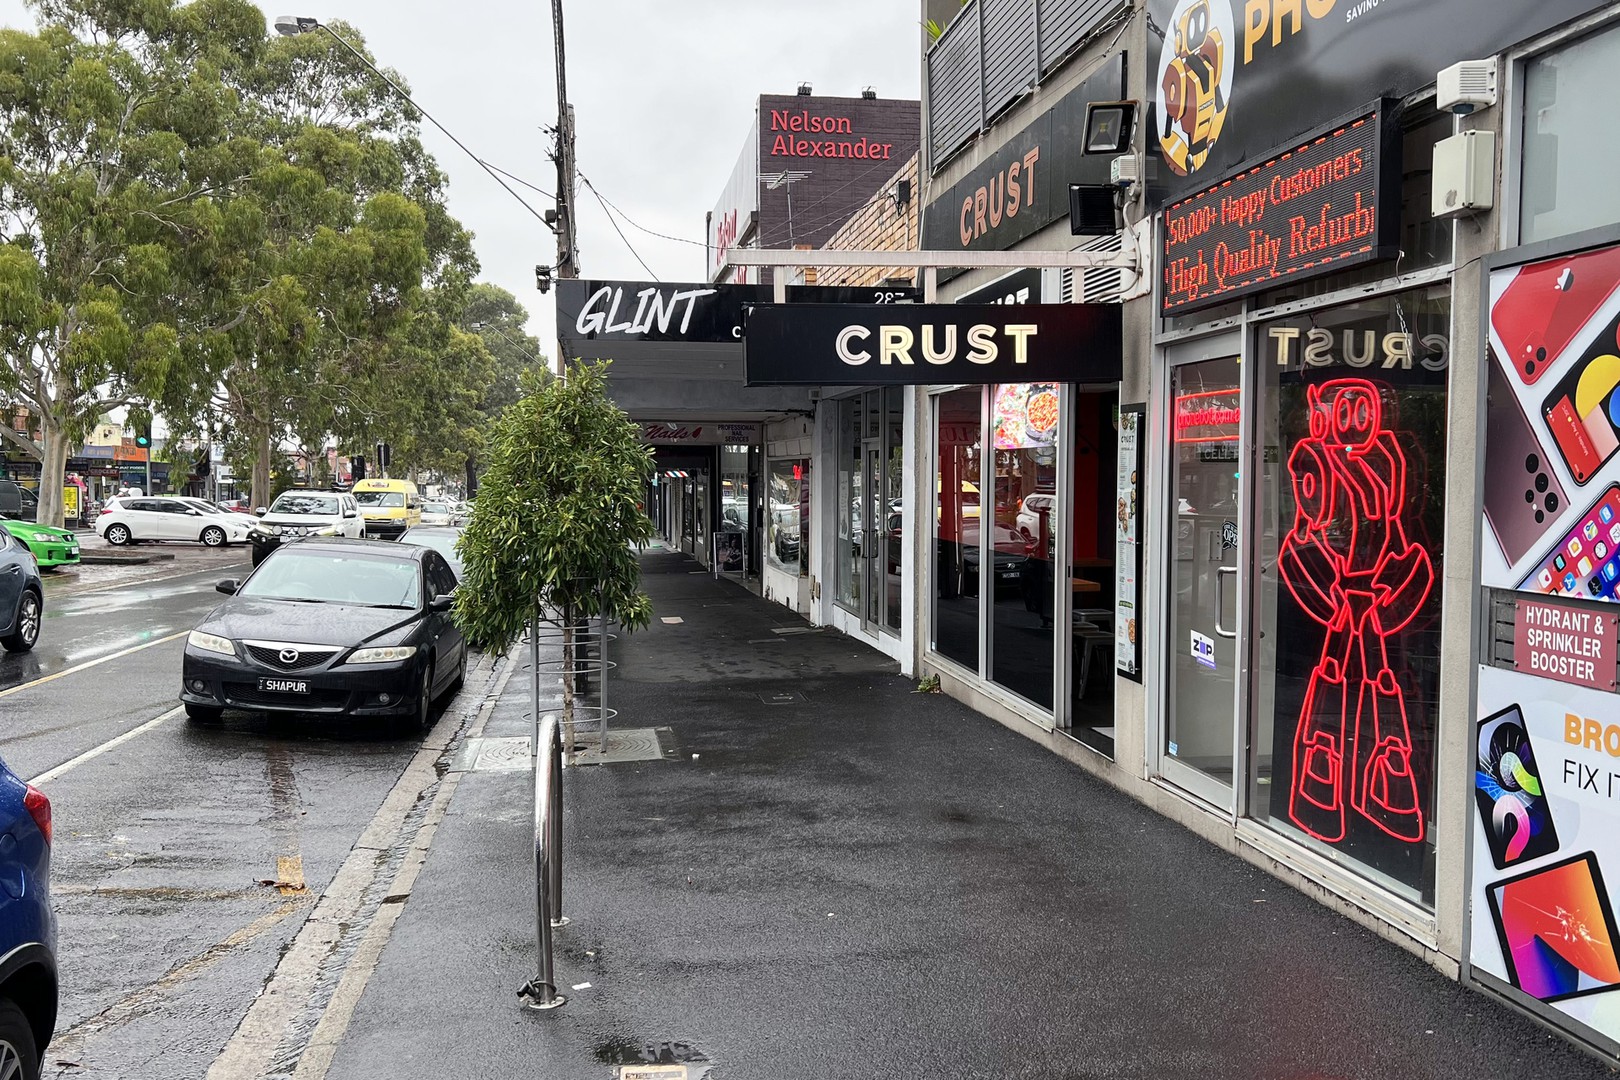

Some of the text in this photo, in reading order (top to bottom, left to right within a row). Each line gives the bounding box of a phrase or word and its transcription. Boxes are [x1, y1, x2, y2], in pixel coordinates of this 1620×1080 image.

[770, 110, 852, 134] Nelson
[771, 134, 892, 159] Alexander
[960, 145, 1040, 247] CRUST
[1170, 147, 1363, 245] 50,000+ Happy Customers
[1170, 250, 1208, 301] High
[1214, 230, 1282, 290] Quality
[576, 286, 717, 335] GLINT
[835, 324, 1038, 366] CRUST
[644, 425, 689, 440] Nails
[1526, 606, 1604, 636] HYDRANT &
[1193, 636, 1213, 656] zip
[1527, 628, 1602, 659] SPRINKLER
[1531, 651, 1595, 681] BOOSTER
[266, 680, 307, 692] SHAPUR
[1563, 759, 1600, 794] FIX
